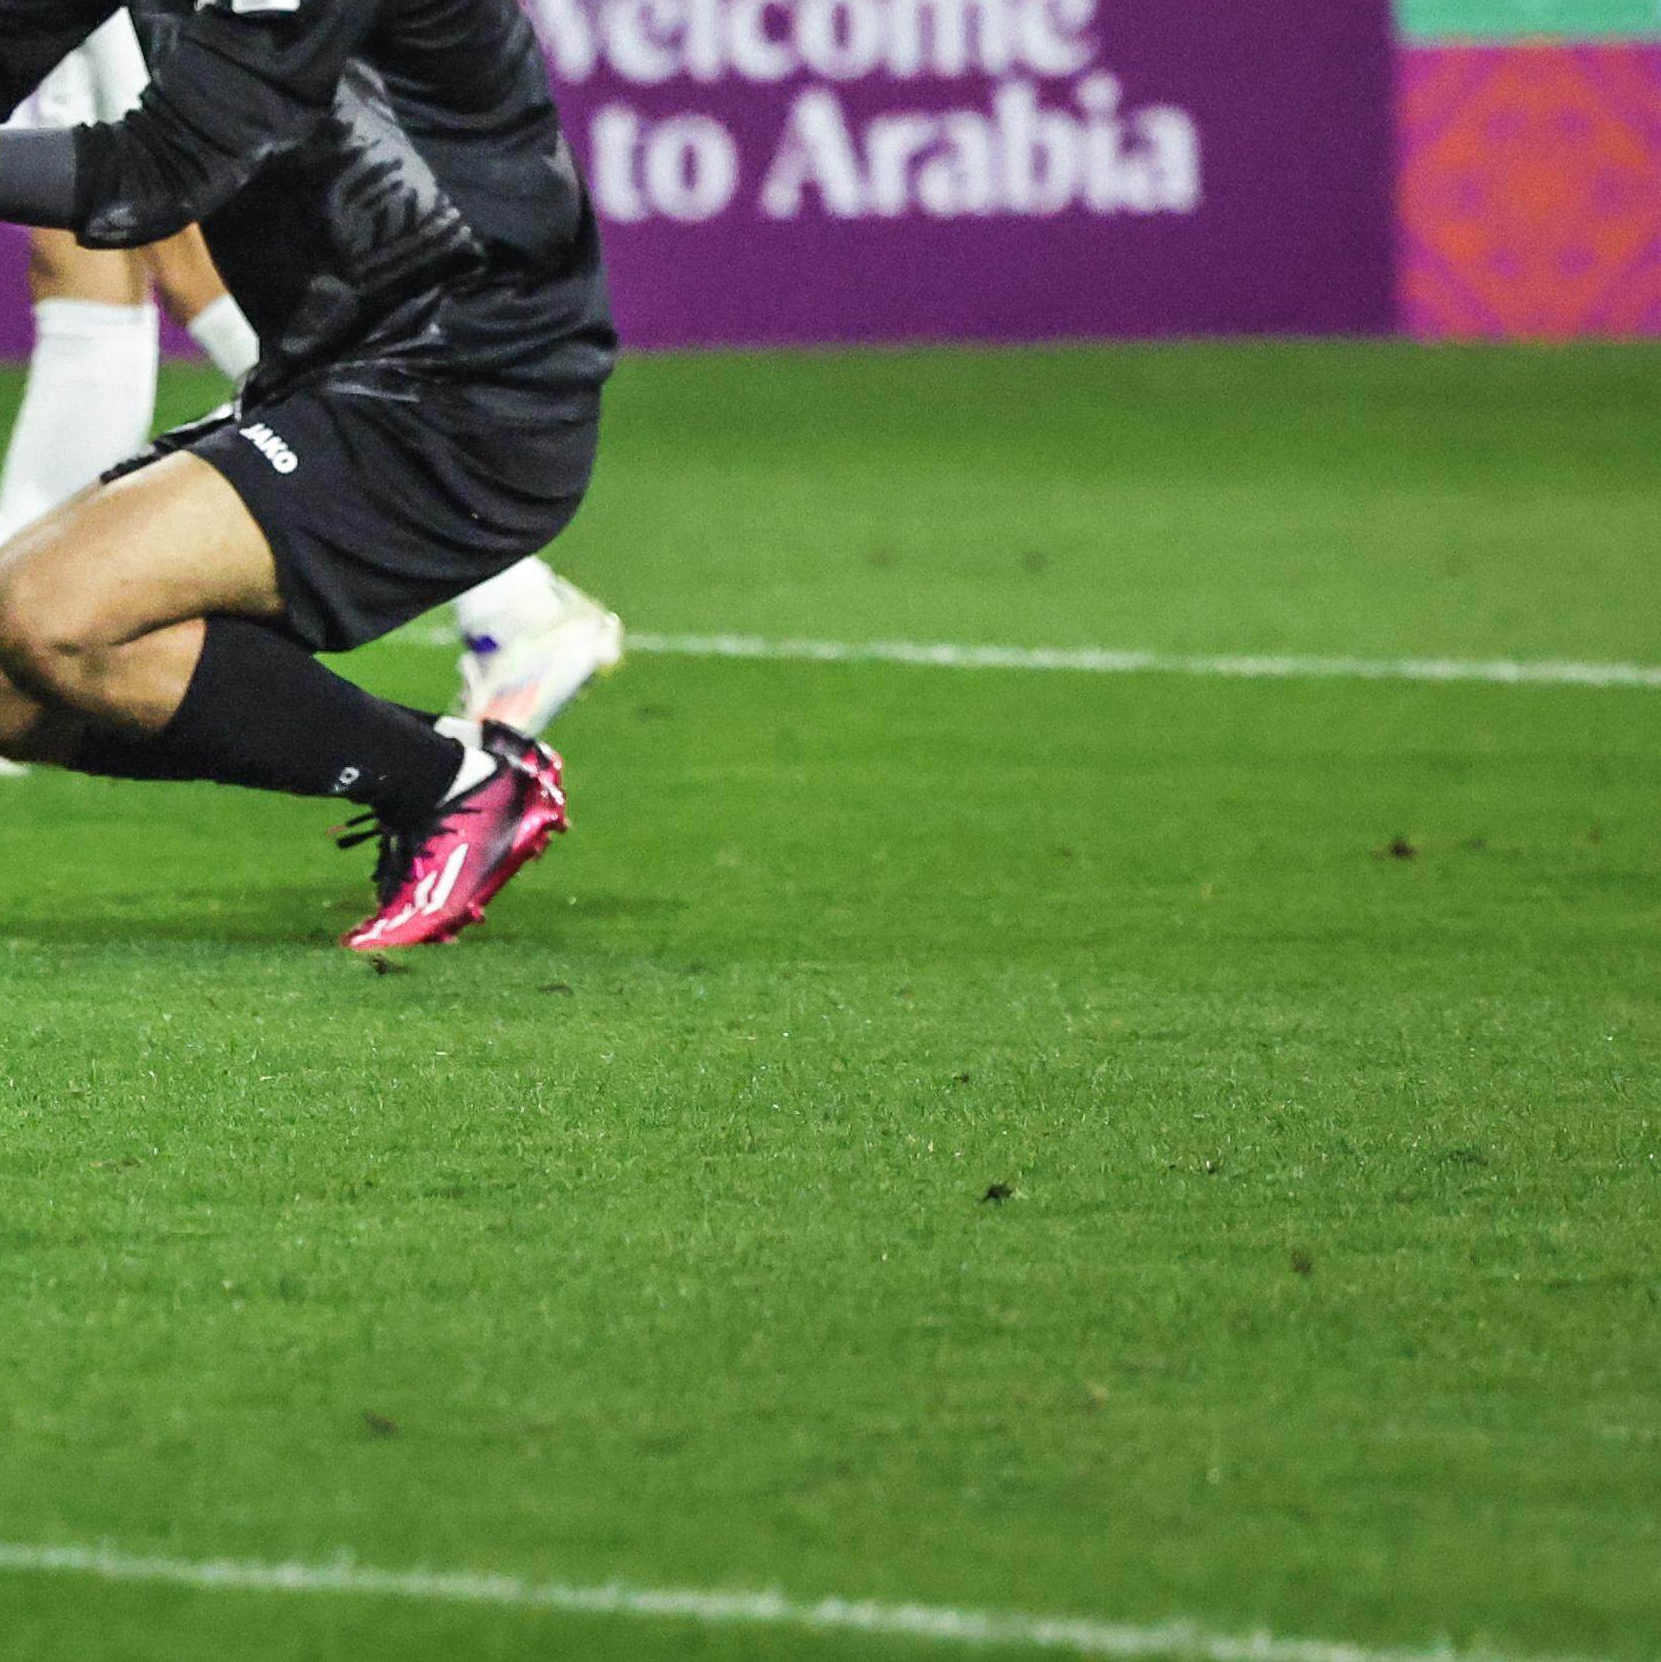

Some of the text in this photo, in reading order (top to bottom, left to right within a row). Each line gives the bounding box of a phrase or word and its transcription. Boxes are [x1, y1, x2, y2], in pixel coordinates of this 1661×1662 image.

[587, 72, 1202, 224] to Arabia
[239, 422, 298, 474] JAKO
